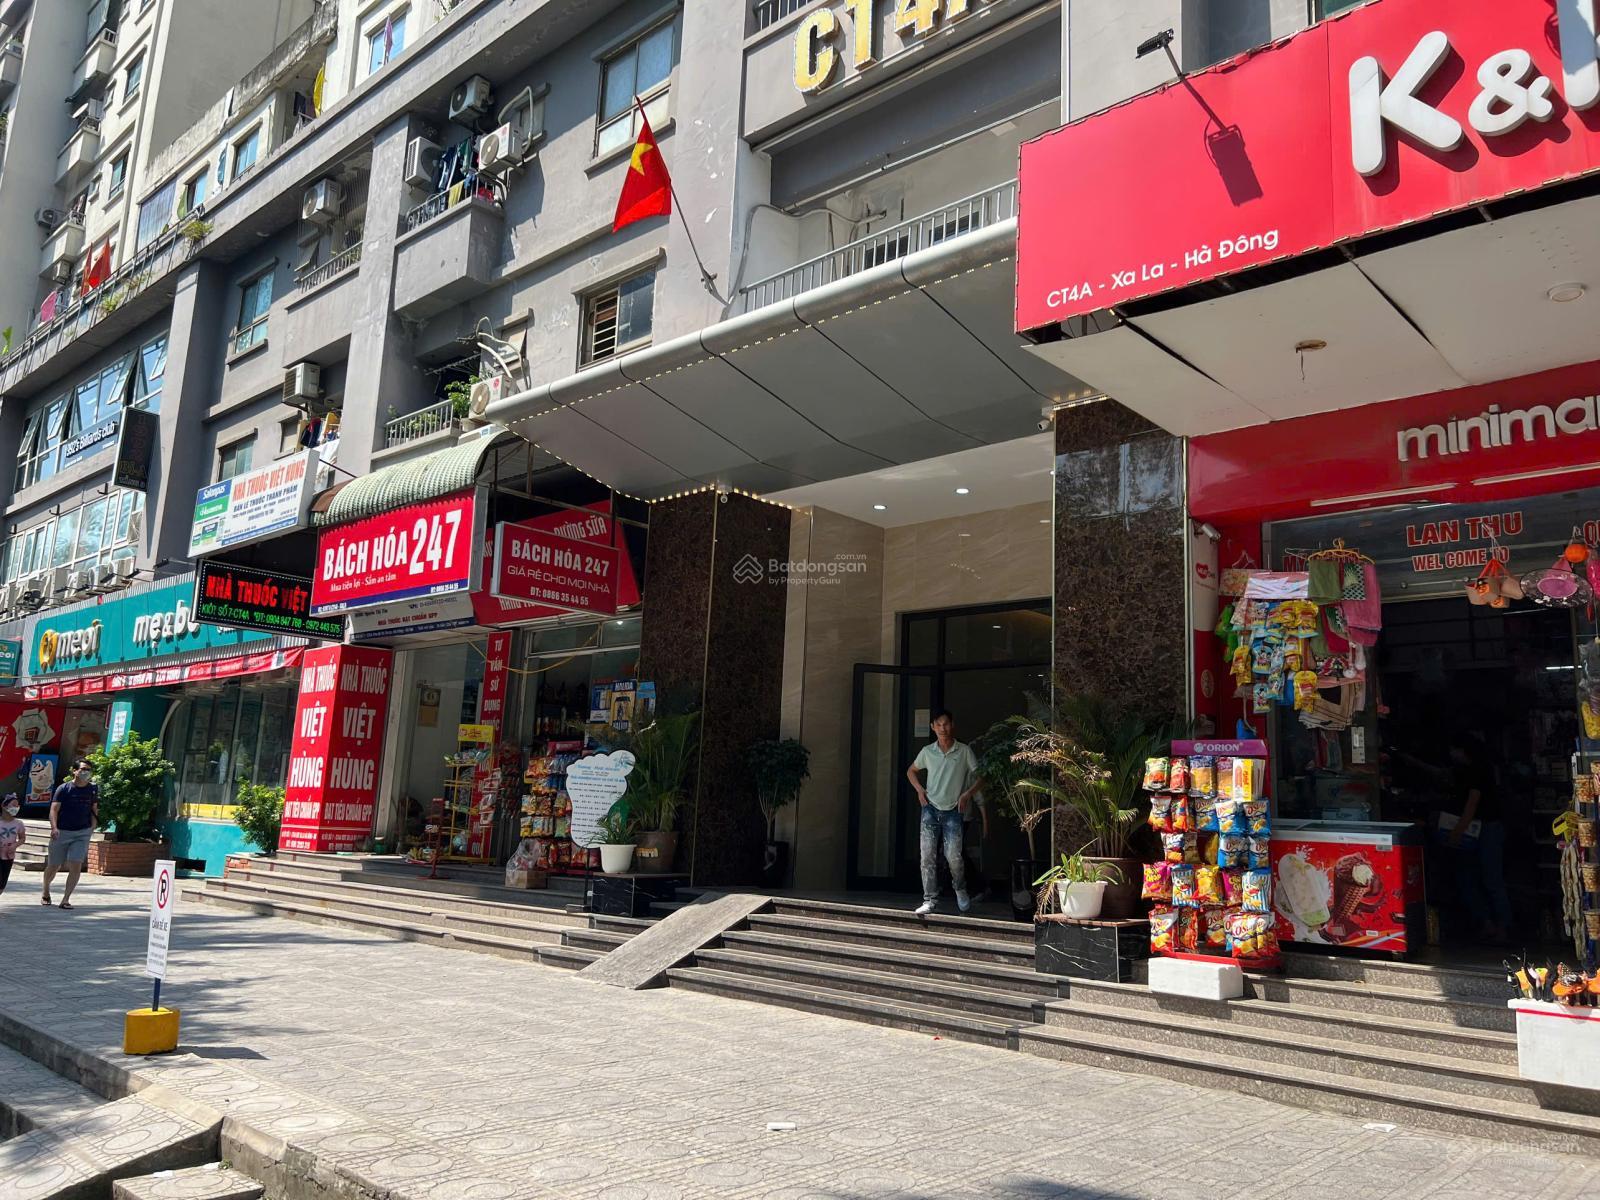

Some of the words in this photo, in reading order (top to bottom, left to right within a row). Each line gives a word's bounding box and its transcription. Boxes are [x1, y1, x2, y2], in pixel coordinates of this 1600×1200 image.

[1047, 282, 1093, 308] CT4A
[1111, 271, 1136, 291] Xa
[1142, 263, 1164, 281] La
[1184, 245, 1213, 269] Hà
[1218, 229, 1279, 259] Đông
[1397, 394, 1600, 462] minima
[323, 538, 370, 582] BÁCH
[371, 526, 408, 572] HÓA
[409, 508, 462, 576] 247
[1405, 519, 1460, 548] LAN
[1583, 519, 1600, 550] Q
[511, 538, 551, 566] BÁCH
[554, 547, 583, 573] HÓA
[585, 556, 610, 578] 247
[1411, 554, 1444, 573] WEL
[1445, 548, 1488, 569] COME
[206, 572, 232, 600] NHÀ
[238, 577, 279, 608] THUỐC
[281, 585, 309, 615] VIỆT
[330, 581, 342, 592] Mua
[507, 564, 526, 577] GIÁ
[527, 568, 543, 581] RẺ
[543, 571, 567, 586] CHO
[567, 575, 587, 590] MỌI
[587, 580, 611, 594] NHÀ
[301, 660, 317, 693] NHÀ
[316, 654, 337, 693] THUỐC
[340, 659, 359, 693] NHÀ
[359, 657, 388, 694] THUỐC
[300, 700, 327, 745] VIỆT
[342, 702, 376, 746] VIỆT
[1207, 743, 1240, 752] ORION
[290, 751, 324, 789] HÙNG
[330, 751, 375, 790] HÙNG
